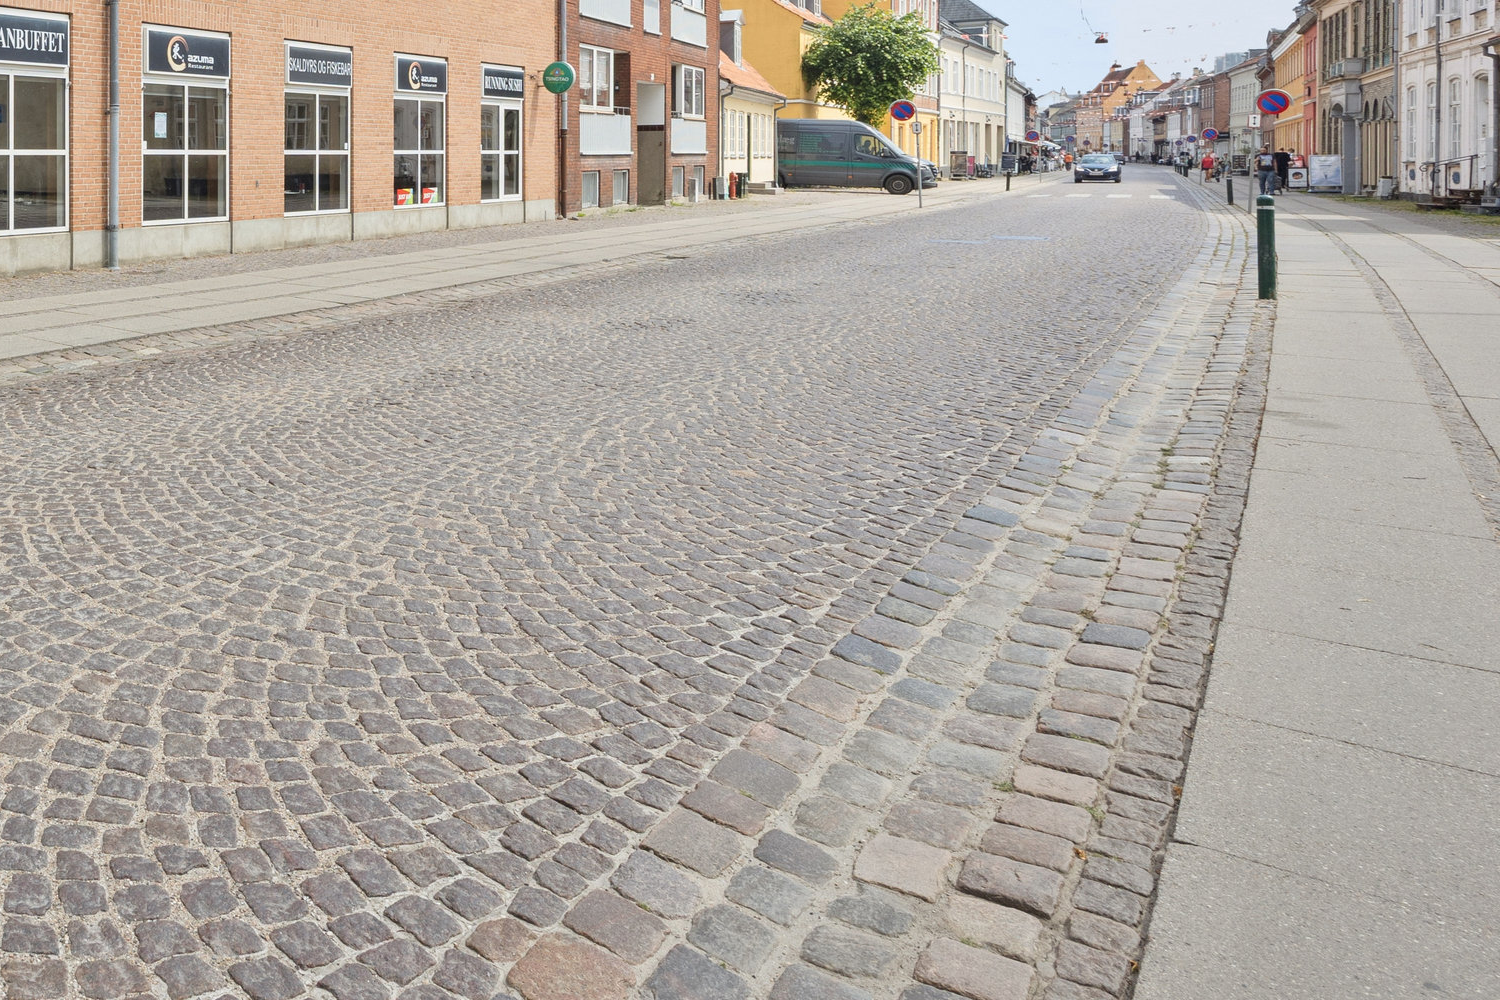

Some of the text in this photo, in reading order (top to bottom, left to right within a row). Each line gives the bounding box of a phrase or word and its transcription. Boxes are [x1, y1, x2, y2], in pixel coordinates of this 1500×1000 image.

[187, 54, 214, 64] azuma
[188, 63, 214, 71] Restaurant
[289, 57, 351, 76] SKALDYRS OG FISKEBAR
[485, 76, 523, 92] RUNNING SUSHI
